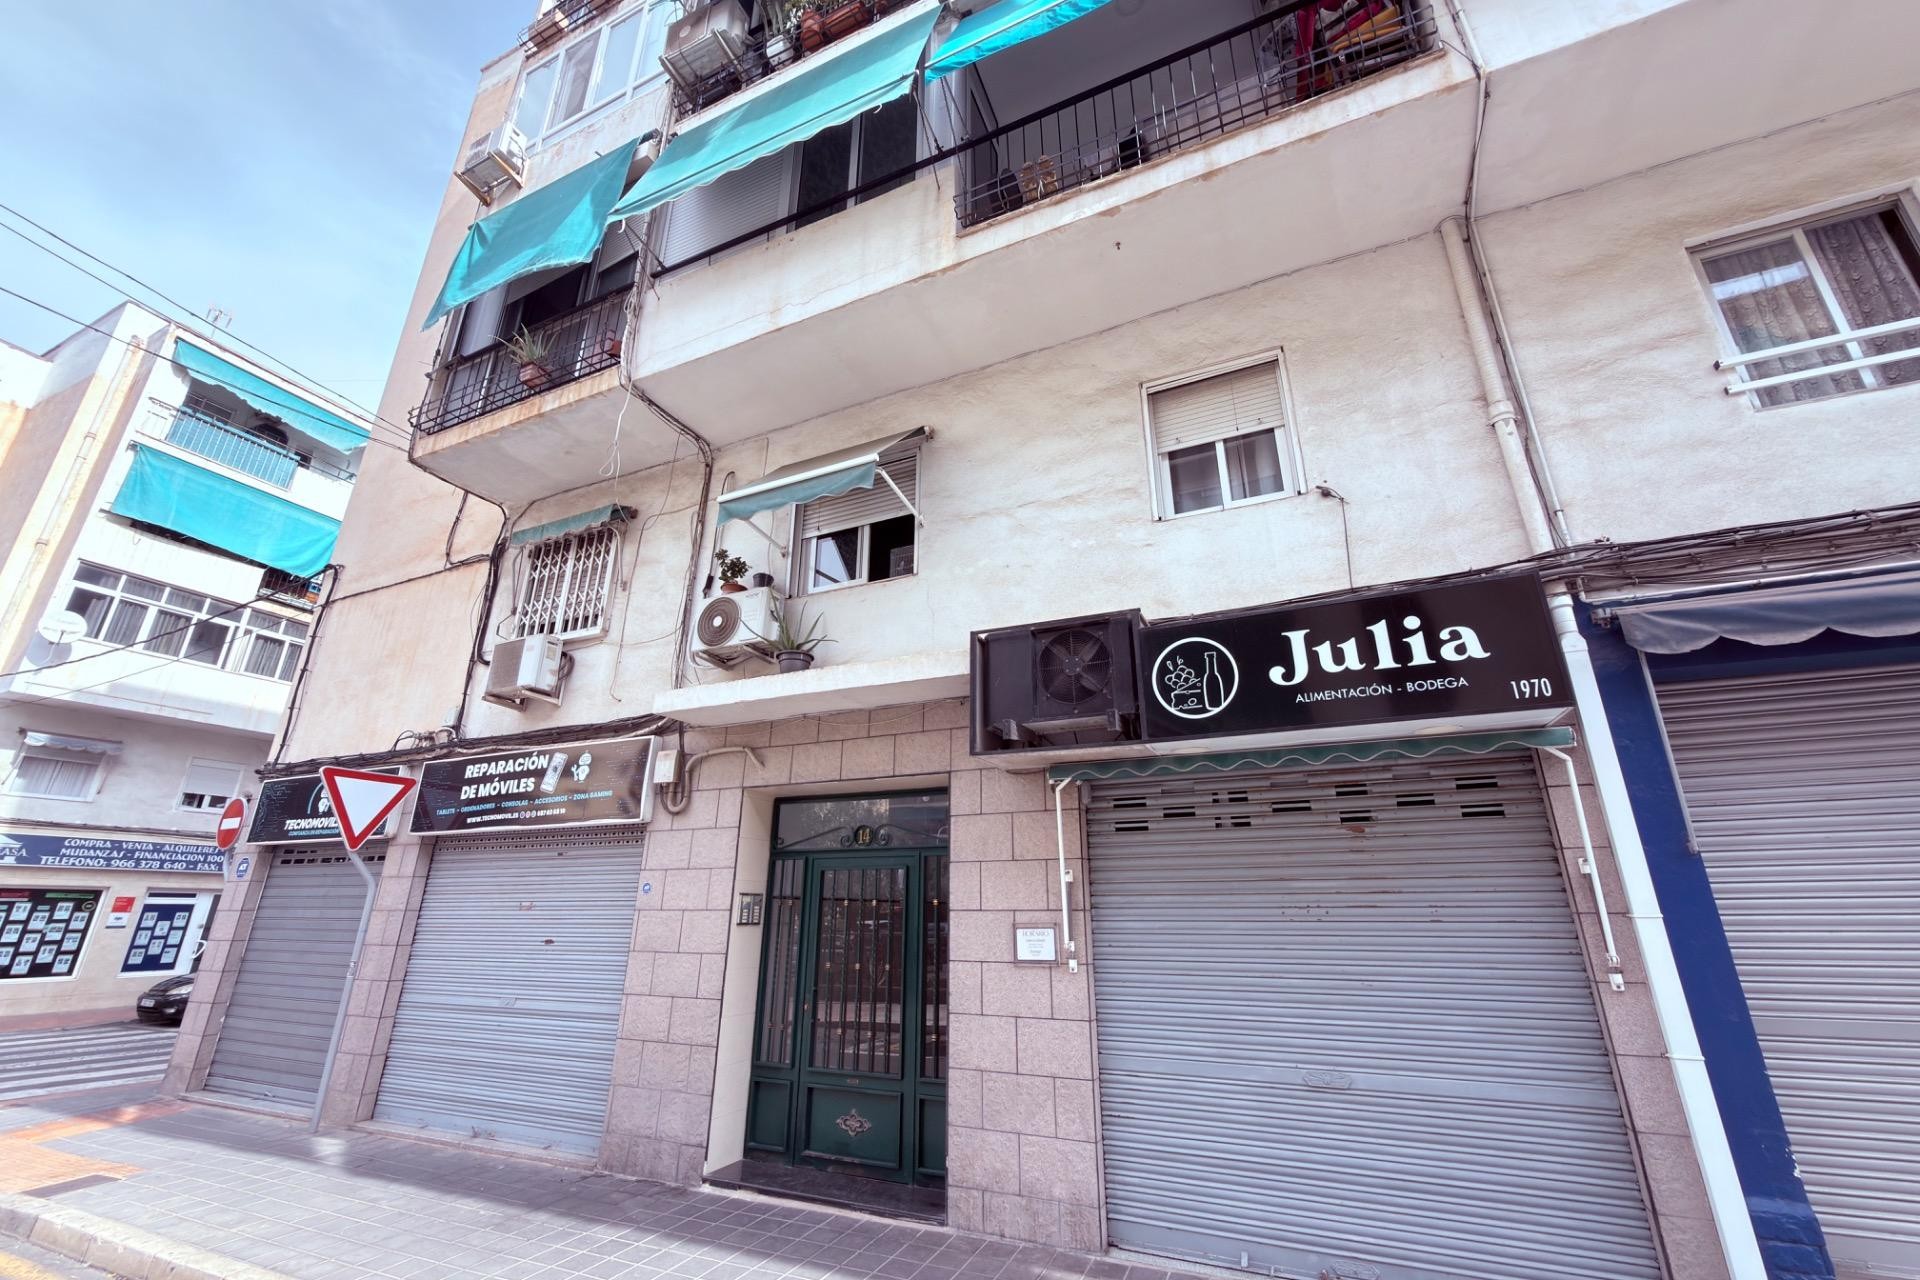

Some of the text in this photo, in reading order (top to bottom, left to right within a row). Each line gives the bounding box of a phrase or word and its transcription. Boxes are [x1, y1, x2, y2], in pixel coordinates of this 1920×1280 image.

[1268, 615, 1491, 686] Julia
[1295, 682, 1393, 703] ALIMENTACIÓN
[1406, 676, 1469, 692] BODEGA
[1510, 677, 1552, 699] 1970
[464, 751, 550, 779] REPARACIÓN
[460, 777, 535, 800] DE MÓVILES
[573, 792, 589, 800] ZONA
[60, 848, 126, 858] MUDANZAS
[134, 851, 205, 862] FINANCIACION
[64, 838, 112, 848] COMPRA
[122, 841, 154, 850] VENTA
[111, 859, 136, 868] 966
[138, 860, 160, 869] 378
[163, 861, 187, 870] 640
